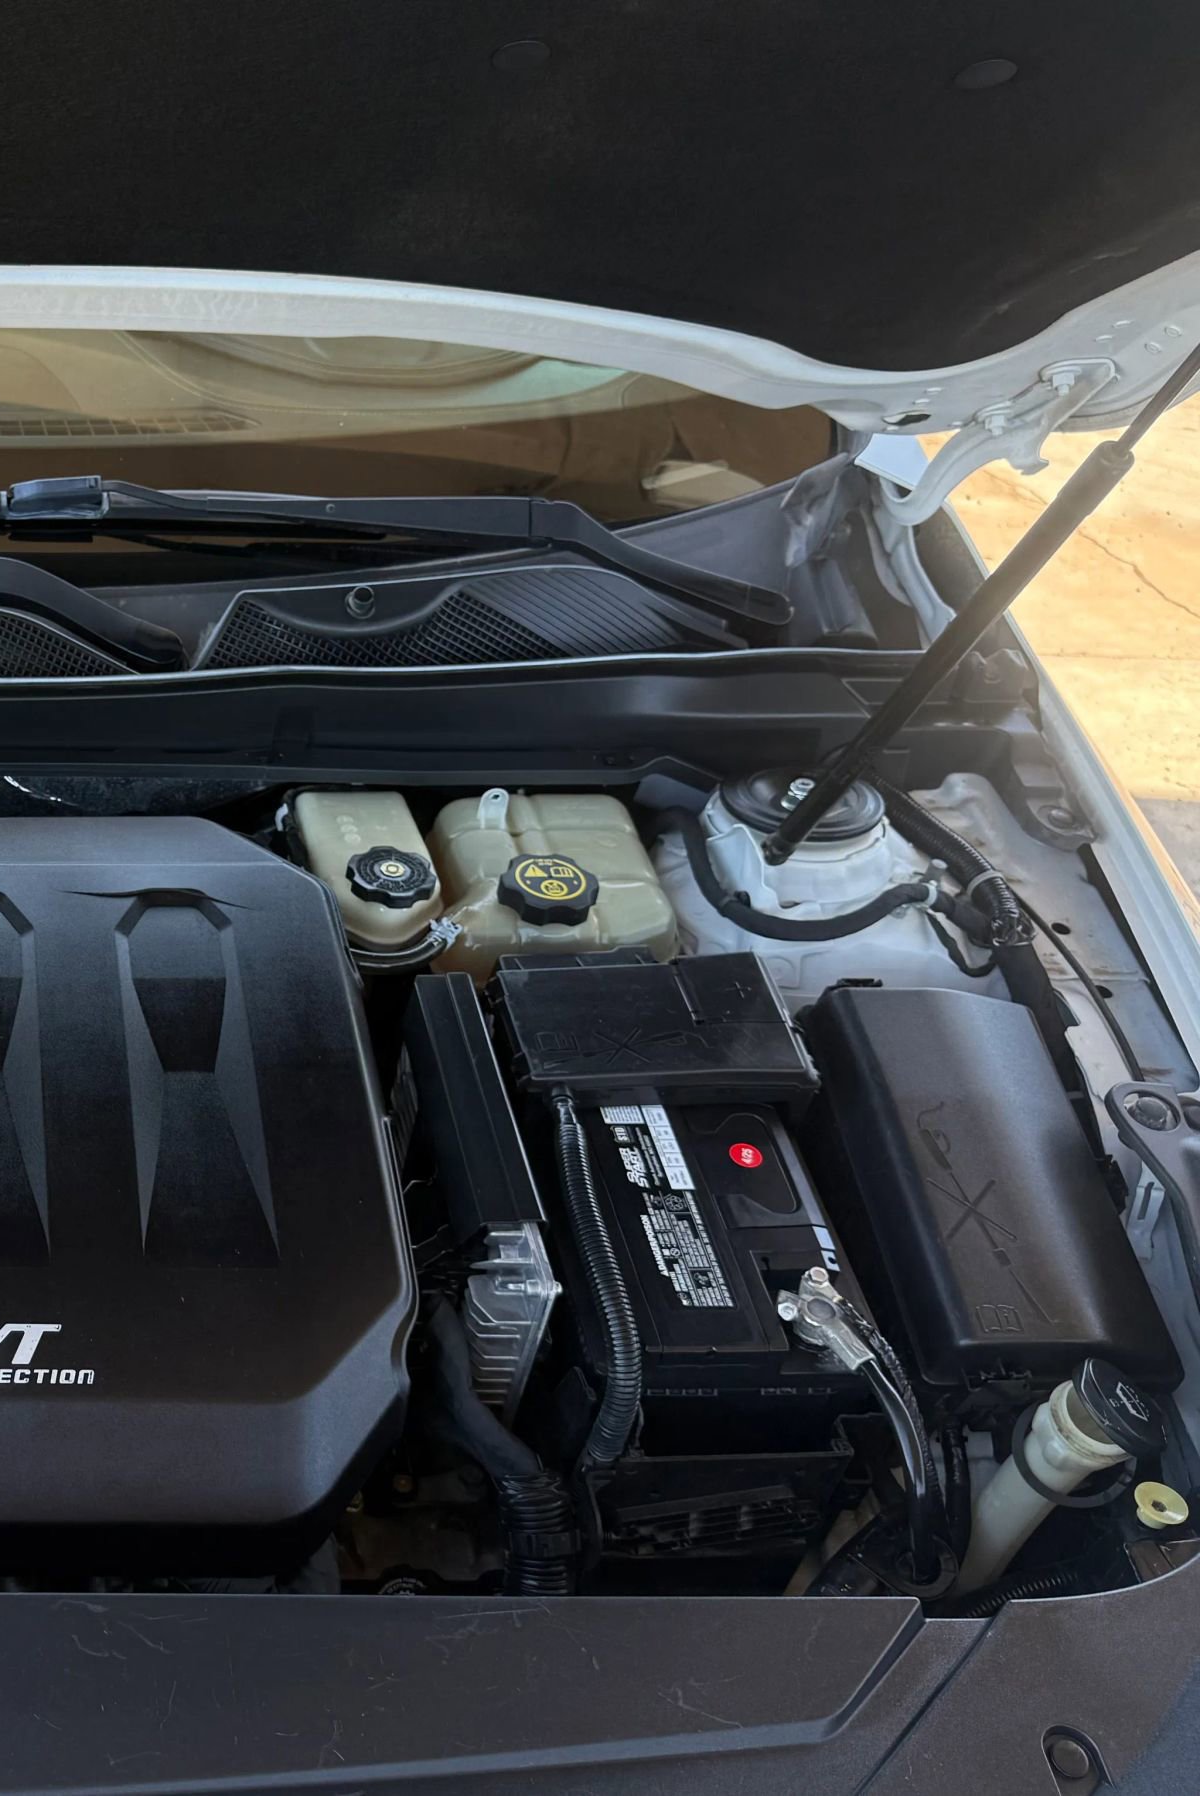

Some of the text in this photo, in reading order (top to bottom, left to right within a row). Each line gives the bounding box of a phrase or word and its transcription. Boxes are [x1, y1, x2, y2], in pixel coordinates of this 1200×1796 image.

[614, 1127, 629, 1141] STD
[618, 1147, 636, 1183] SUPER
[630, 1146, 650, 1188] START
